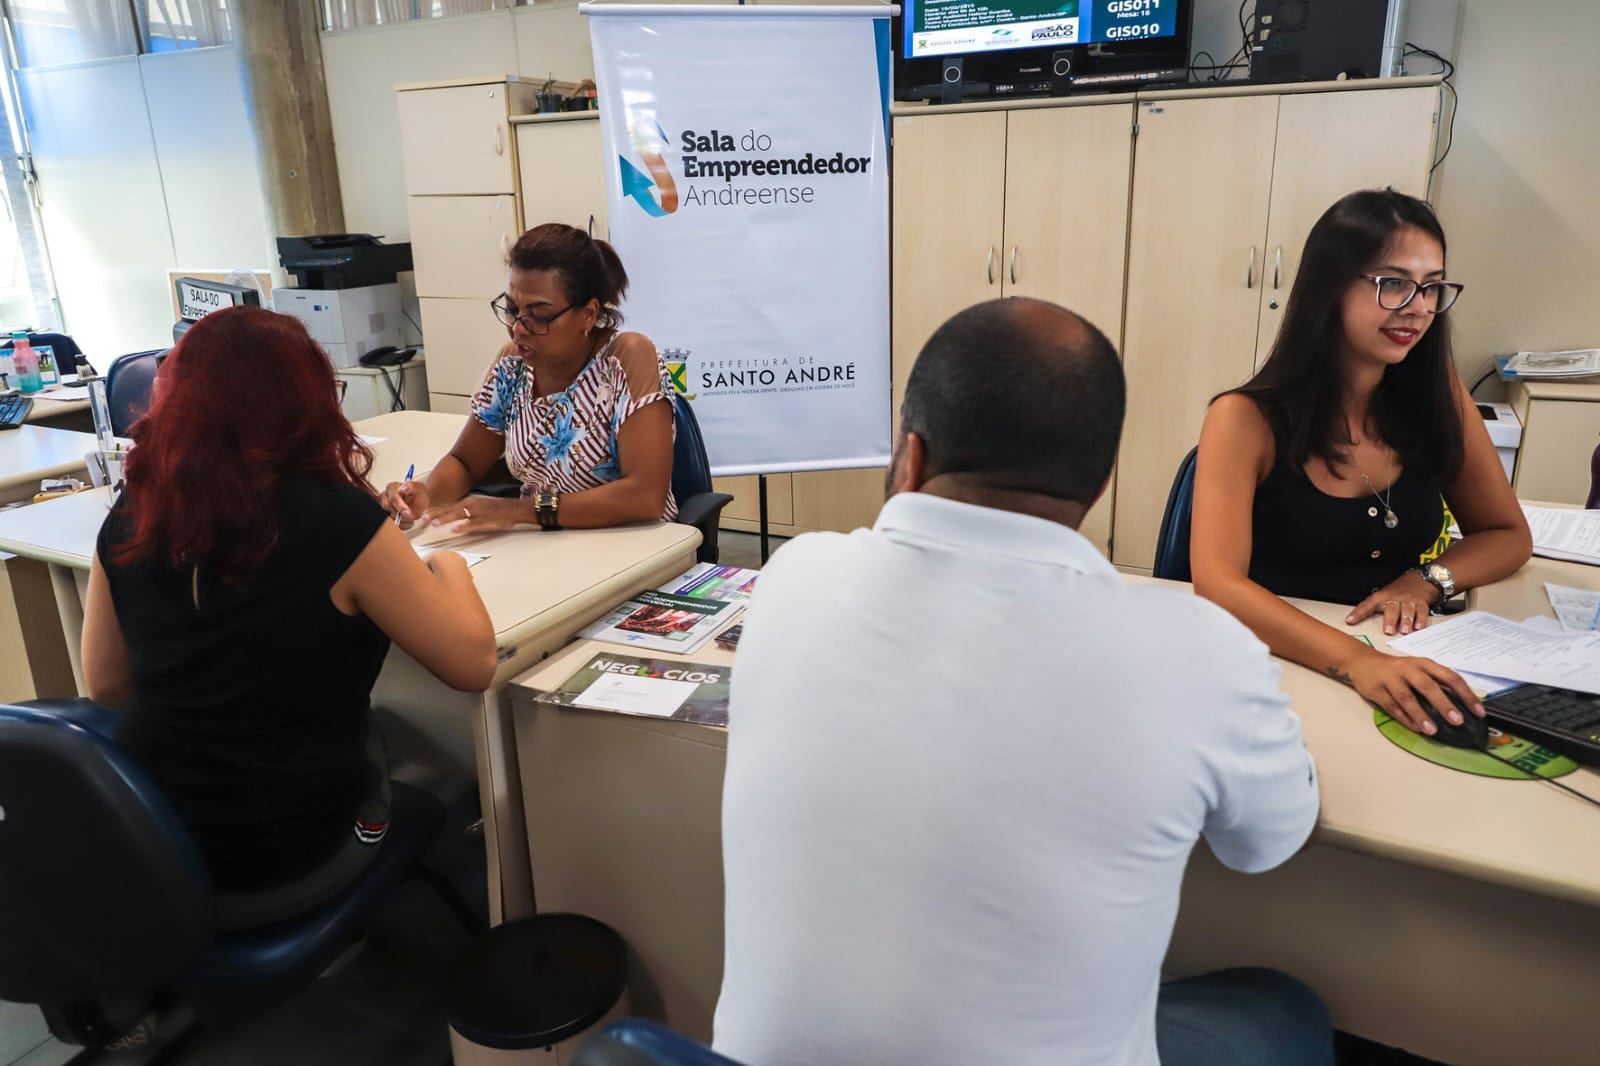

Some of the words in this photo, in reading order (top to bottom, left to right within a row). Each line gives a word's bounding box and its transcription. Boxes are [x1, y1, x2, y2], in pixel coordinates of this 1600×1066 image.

[1107, 0, 1160, 13] GIS011
[1031, 31, 1074, 39] PAULO
[1047, 24, 1074, 32] SÃO
[1106, 23, 1160, 38] GIS010
[681, 129, 736, 153] Sala
[740, 129, 772, 152] do
[681, 152, 872, 182] Empreendedor
[683, 184, 815, 207] Andreense
[190, 288, 209, 304] SALA
[209, 292, 220, 307] DO
[701, 357, 789, 369] PREFEITURA
[799, 355, 815, 365] DE
[702, 369, 775, 388] SANTO
[785, 361, 855, 384] ANDRÉ
